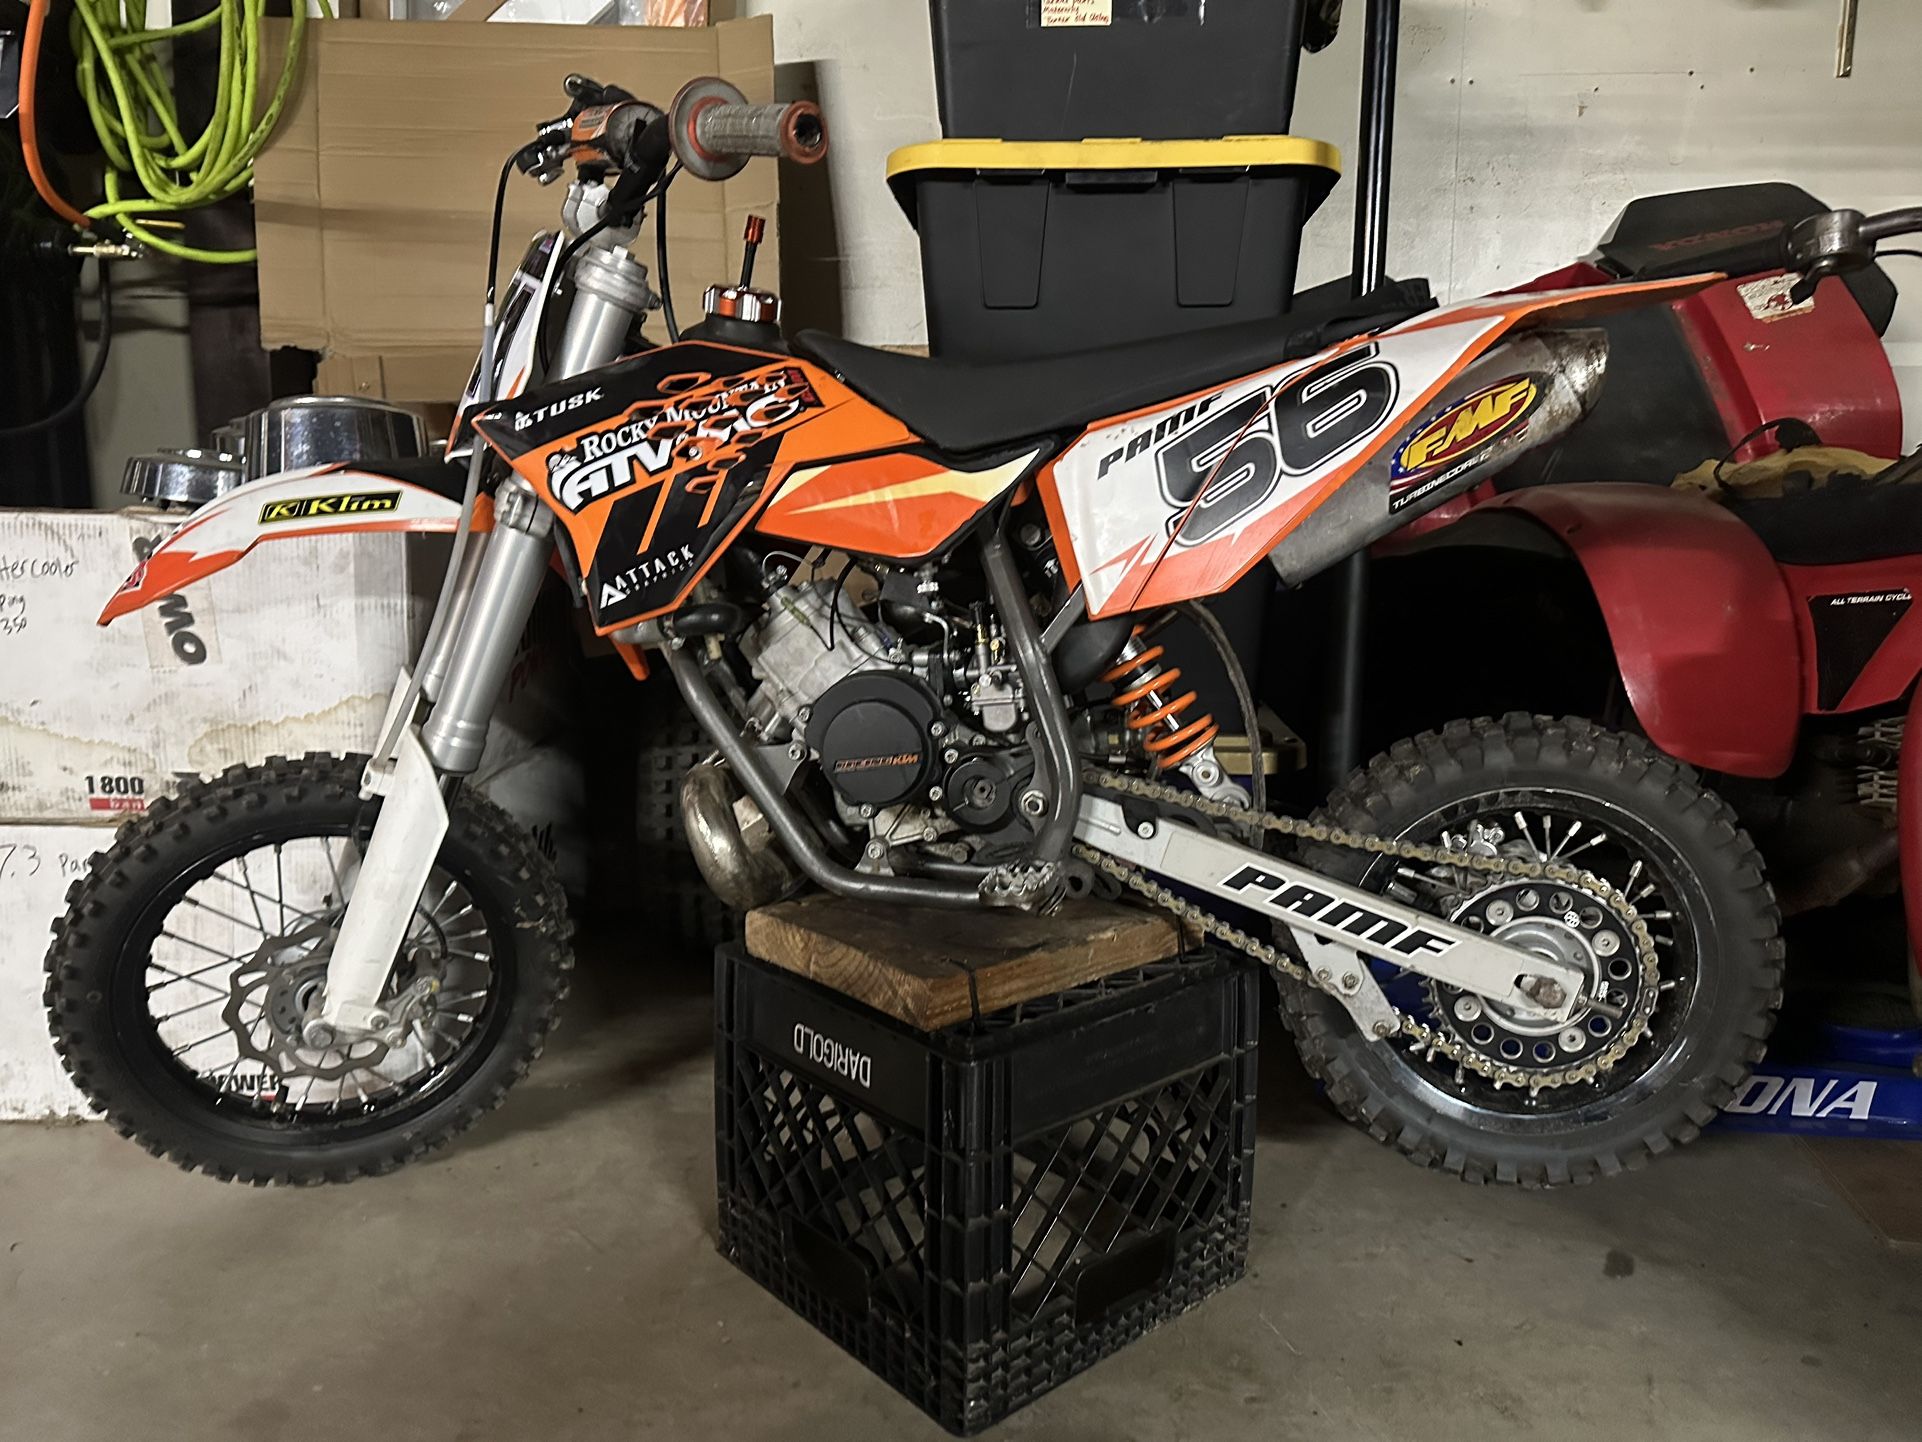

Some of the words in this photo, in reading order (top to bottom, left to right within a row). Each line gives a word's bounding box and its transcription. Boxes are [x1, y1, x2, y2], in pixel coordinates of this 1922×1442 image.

[533, 386, 604, 423] TUSK
[1097, 390, 1225, 481] PAMF
[1406, 377, 1531, 472] FMF
[580, 413, 660, 464] ROCKY
[1155, 341, 1400, 548] 56
[308, 495, 392, 516] Klim
[1830, 598, 1846, 606] ALL
[1847, 594, 1884, 604] TERRAIN
[1217, 863, 1463, 959] PAMF
[794, 1023, 871, 1089] DARIGOLD
